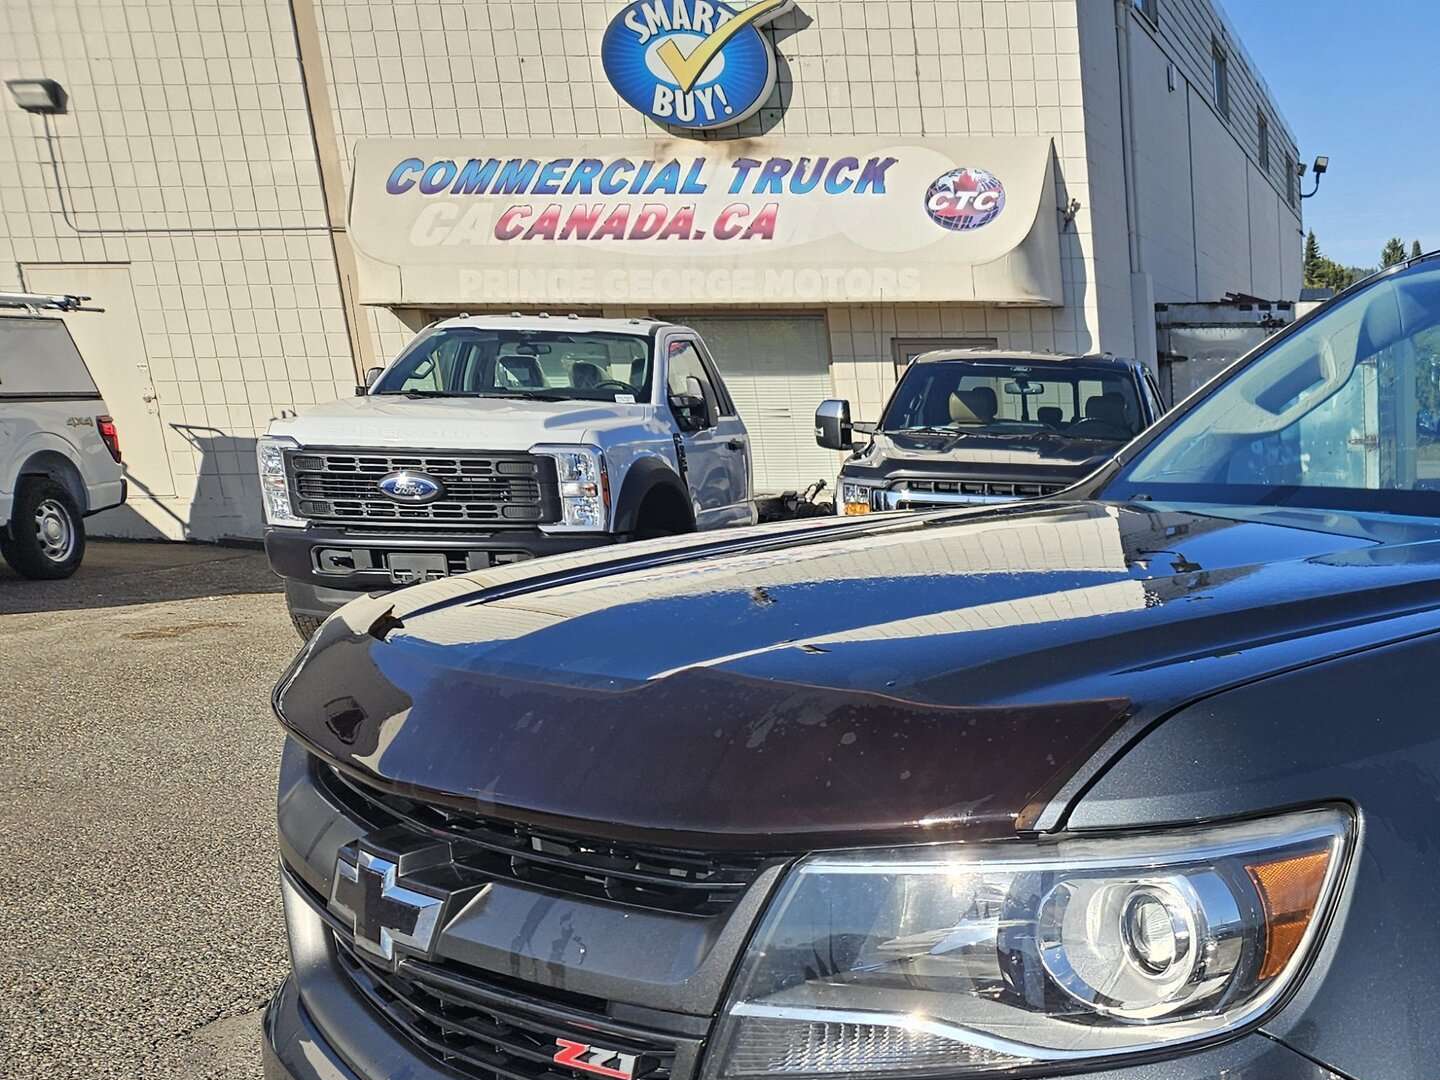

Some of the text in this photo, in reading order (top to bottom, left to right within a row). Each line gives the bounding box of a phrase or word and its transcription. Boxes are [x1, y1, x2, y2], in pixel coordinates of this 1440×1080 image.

[624, 0, 737, 45] SMART
[652, 83, 733, 122] BUY!
[386, 156, 899, 195] COMMERCIAL TRUCK
[927, 190, 1003, 211] CTC
[494, 202, 780, 241] CANADA.CA
[458, 266, 921, 299] PRINCE GEORGE MOTORS
[553, 1037, 640, 1080] Z71
